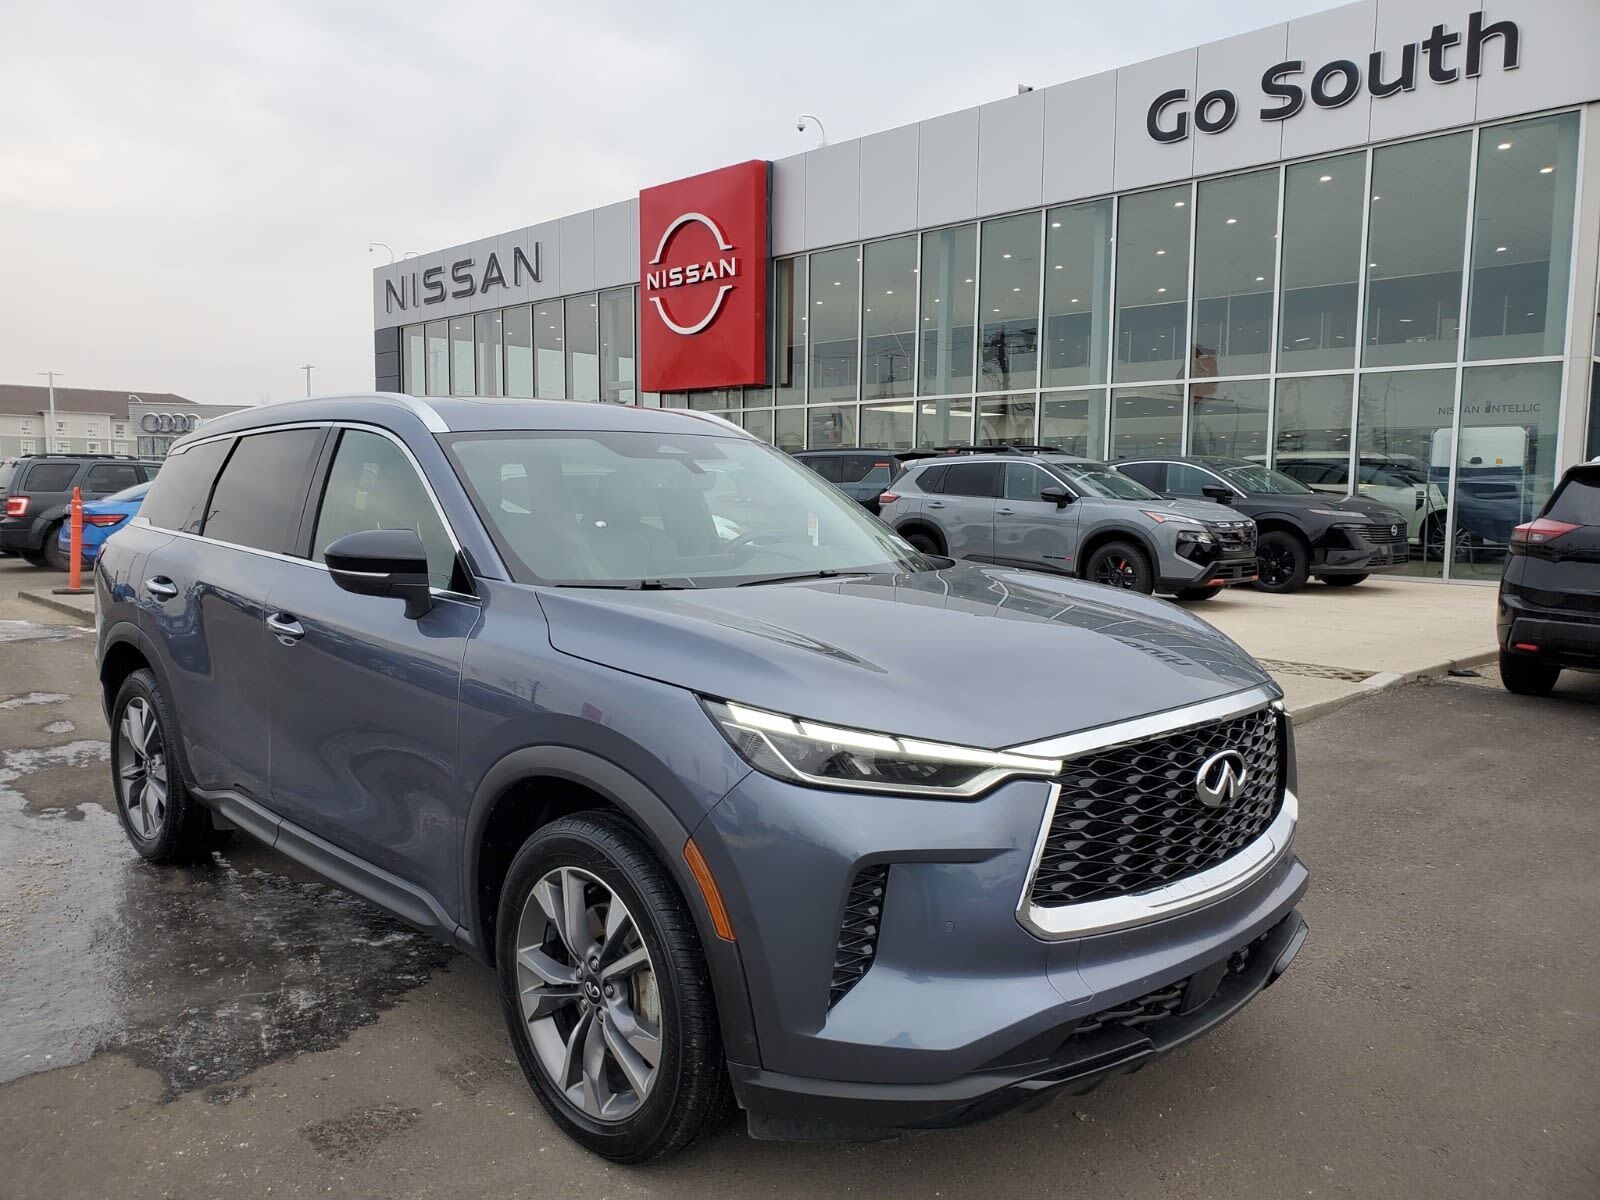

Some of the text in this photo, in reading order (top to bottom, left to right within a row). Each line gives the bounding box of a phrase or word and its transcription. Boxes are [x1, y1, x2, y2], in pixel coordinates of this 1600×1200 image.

[1146, 11, 1520, 144] Go South
[385, 241, 543, 313] NISSAN
[646, 256, 738, 292] NISSAN
[1438, 405, 1480, 416] NISAN
